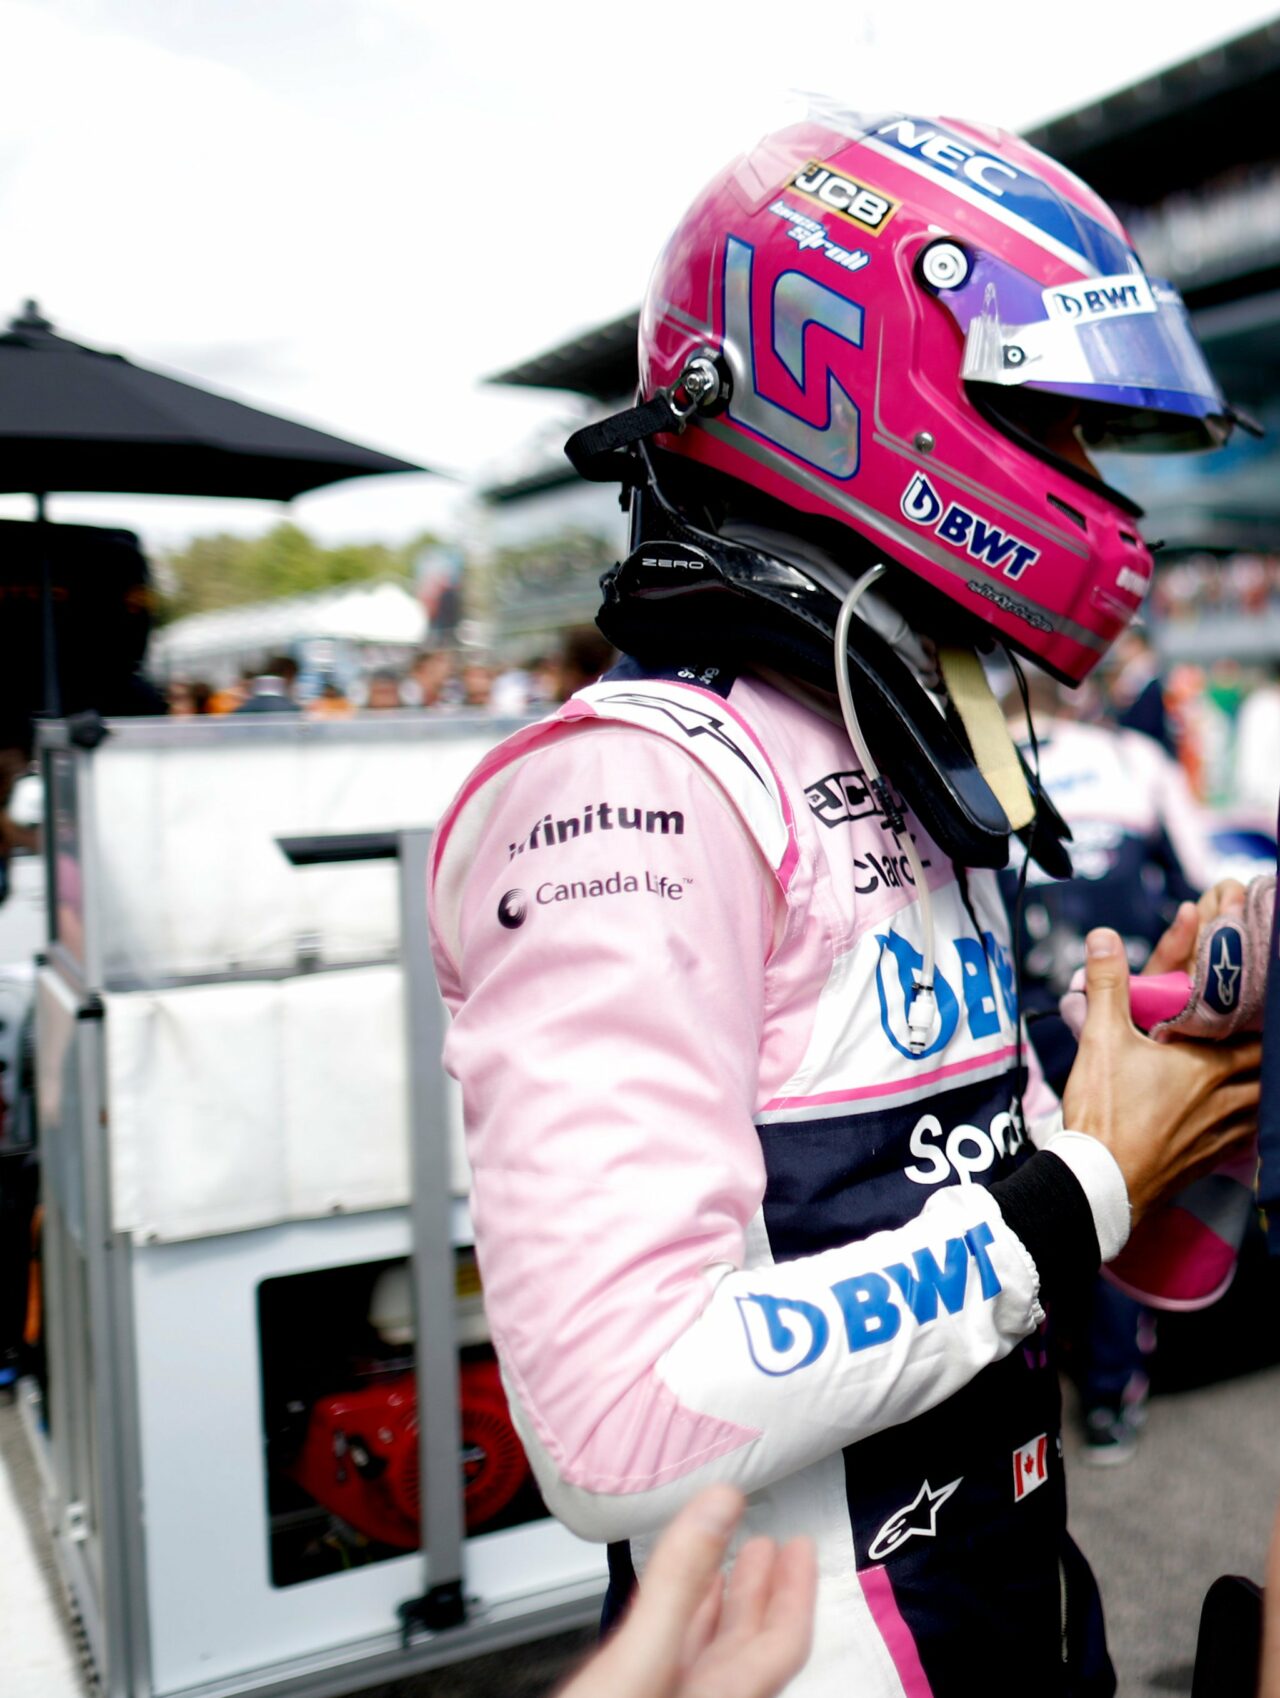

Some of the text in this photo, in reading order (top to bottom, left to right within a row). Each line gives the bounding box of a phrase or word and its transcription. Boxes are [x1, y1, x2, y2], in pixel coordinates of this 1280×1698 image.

[878, 120, 1017, 197] NEC
[795, 169, 889, 226] JCB
[1084, 285, 1140, 312] BWT
[642, 558, 704, 569] ZERO
[935, 502, 1041, 581] BWT
[509, 802, 685, 861] finitum
[536, 871, 639, 905] Canada
[830, 1221, 1002, 1354] BWT
